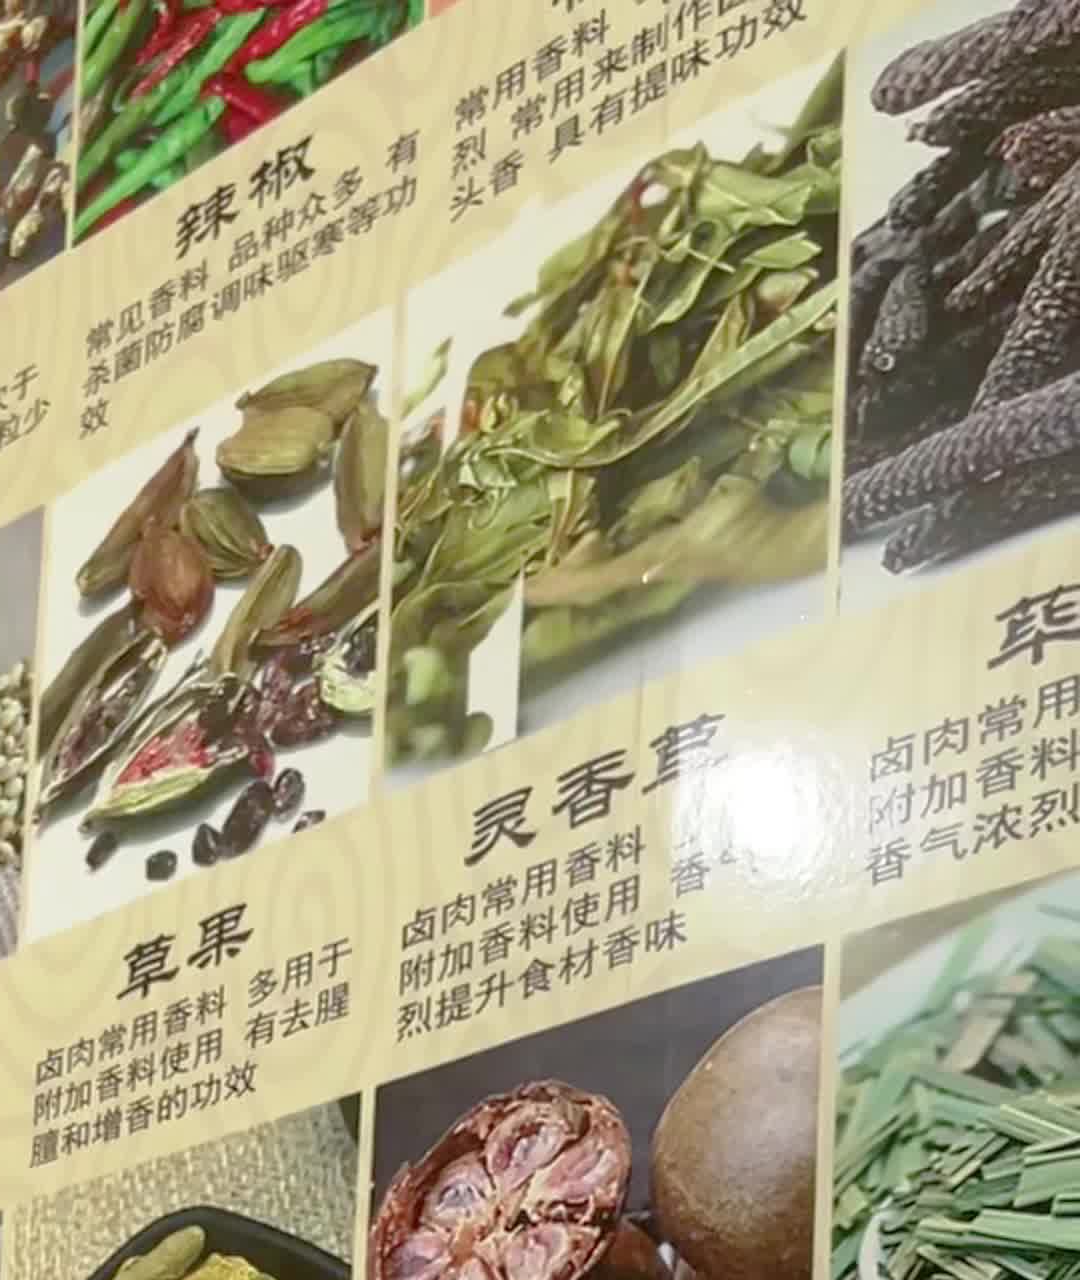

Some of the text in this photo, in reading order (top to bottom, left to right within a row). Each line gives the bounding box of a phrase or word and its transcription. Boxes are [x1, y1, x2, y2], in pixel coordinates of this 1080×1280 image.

[450, 0, 808, 224] 头香 具有提味功效
[455, 8, 610, 132] 常用香料
[175, 134, 316, 261] 辣椒
[452, 127, 487, 182] 烈
[83, 173, 418, 398] 杀菌防腐调味驱寒等功
[86, 130, 420, 359] 常见香料 品种众多 有
[80, 397, 109, 440] 效
[400, 823, 646, 951] 卤肉常用香料
[865, 782, 1080, 887] 香气浓烈
[116, 902, 255, 1001] 草果
[396, 908, 688, 1044] 烈提升食材香味
[398, 873, 641, 997] 附加香料使用
[32, 981, 351, 1127] 附加香料使用 有去腥
[35, 937, 353, 1087] 卤肉常用香料 多用于
[29, 1059, 260, 1169] 膻和增香的功效
